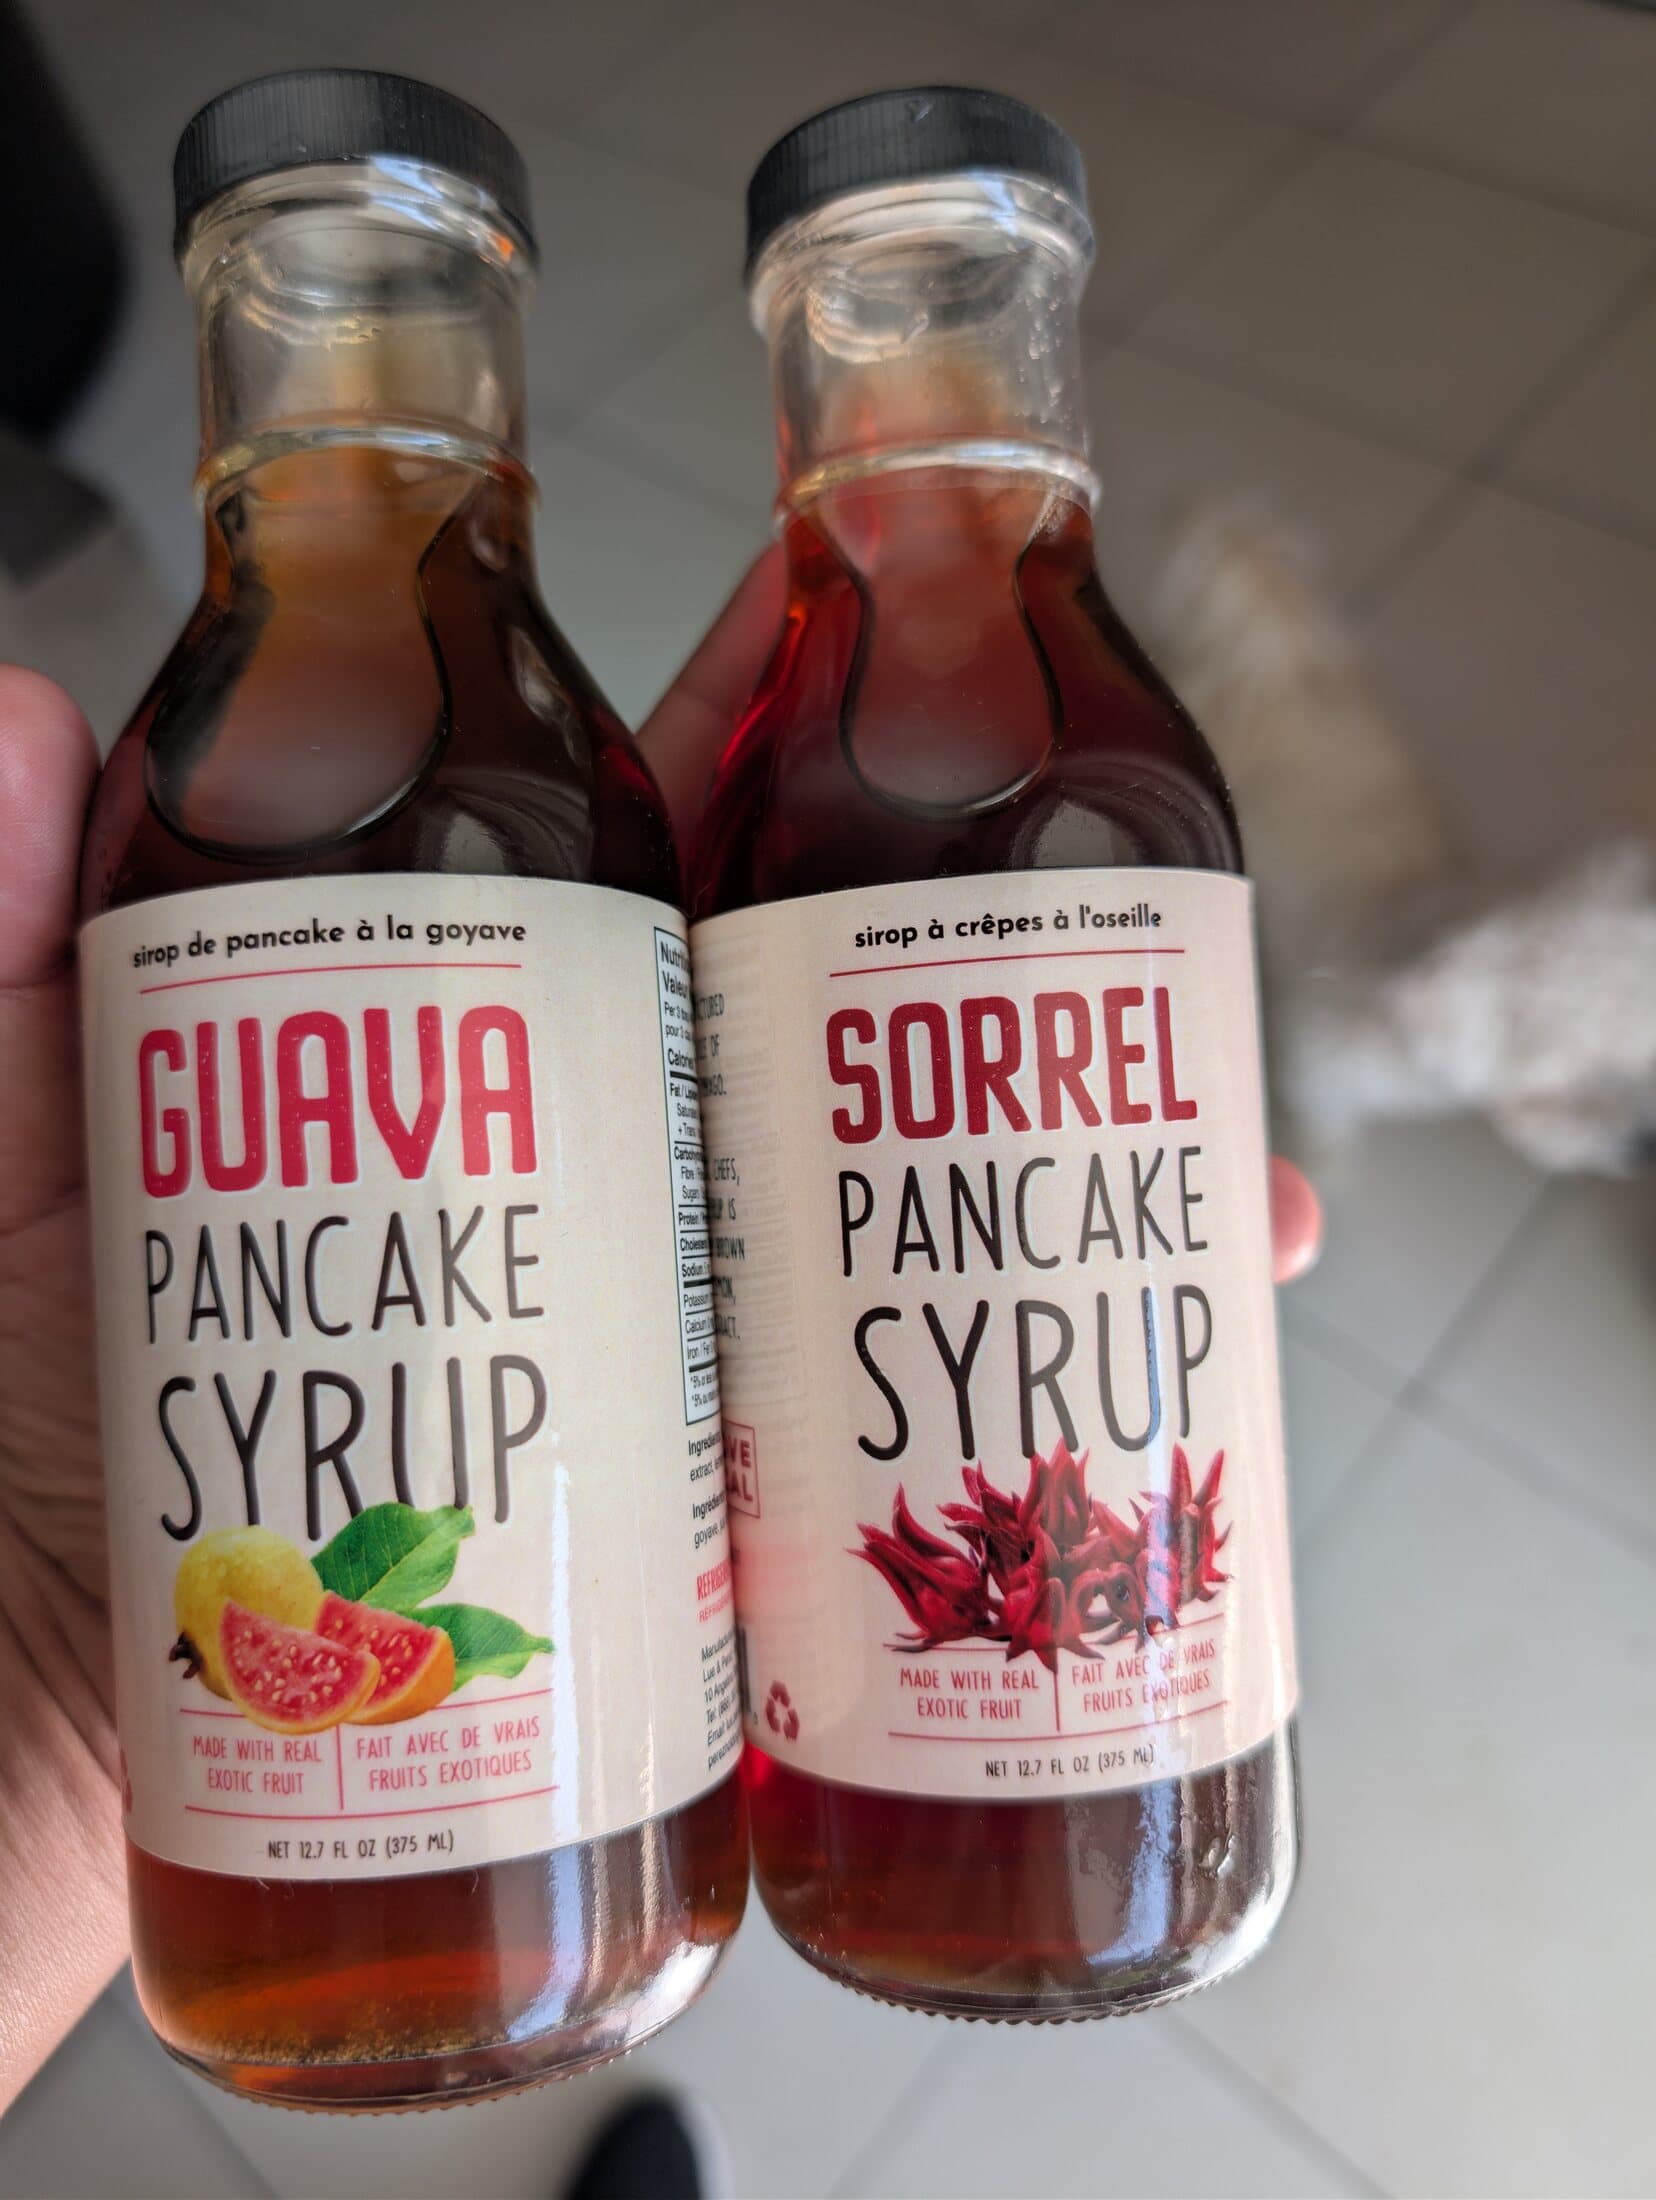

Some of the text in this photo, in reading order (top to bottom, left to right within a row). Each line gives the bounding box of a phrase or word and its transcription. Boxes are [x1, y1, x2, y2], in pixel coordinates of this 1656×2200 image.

[133, 914, 527, 968] sirop de pancake à la goyave
[855, 902, 1162, 948] sirop à crêpes à l'oseille
[826, 986, 1198, 1144] SORREL
[138, 1004, 538, 1198] GUAVA
[838, 1146, 1208, 1278] PANCAKE
[146, 1204, 544, 1344] PANCAKE
[854, 1284, 1212, 1461] SYRUP
[159, 1354, 548, 1542] SYRUP
[900, 1667, 1039, 1690] MADE WITH REAL
[1072, 1638, 1216, 1685] FAIT AVEC DE VRAIS
[917, 1698, 1022, 1720] EXOTIC FRUIT
[1083, 1669, 1210, 1713] FRUITS EXOTIQUES
[192, 1735, 322, 1763] MADE WITH REAL
[357, 1715, 541, 1760] FAIT AVEC DE VRAIS
[208, 1770, 304, 1795] EXOTIC FRUIT
[369, 1749, 532, 1791] FRUITS EXOTIQUES
[985, 1744, 1155, 1777] NET 12.7 FL OZ (375 ML)
[267, 1828, 454, 1859] NET 12.7 FL OZ (375 ML)
